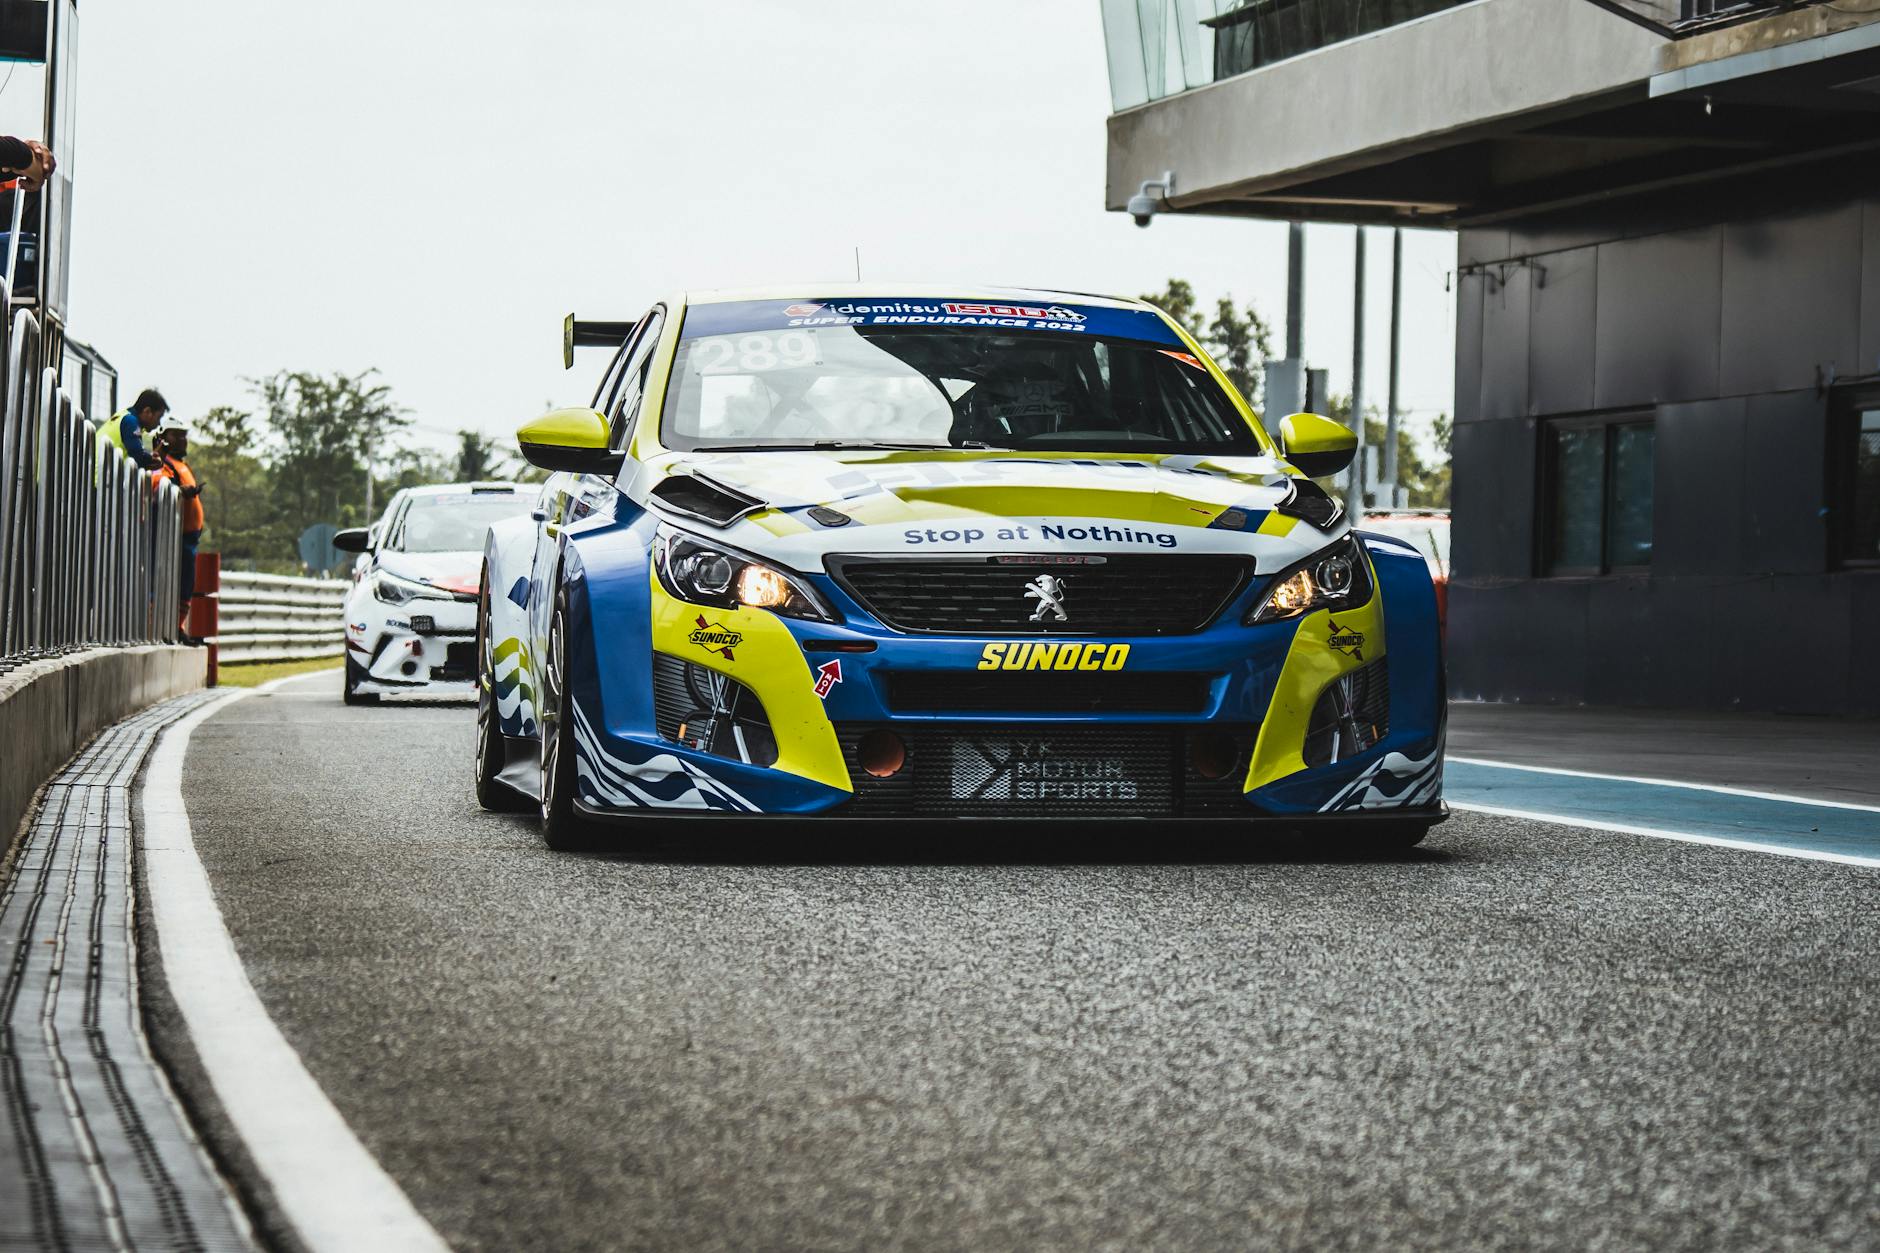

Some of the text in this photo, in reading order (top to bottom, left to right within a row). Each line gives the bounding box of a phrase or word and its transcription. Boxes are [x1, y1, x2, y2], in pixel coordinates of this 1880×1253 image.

[829, 303, 939, 314] idemitsu
[788, 316, 865, 327] SUPER
[873, 315, 1030, 327] ENDURANCE
[1034, 320, 1086, 331] 2022
[698, 332, 817, 376] 289
[905, 524, 1178, 548] Stop at Nothing
[692, 630, 738, 645] SUNOCO
[1331, 635, 1363, 647] SUNOCO
[977, 643, 1131, 672] SUNOCO
[818, 673, 832, 693] TOW
[1017, 760, 1126, 779] MOTOR
[1017, 780, 1137, 799] SPORTS
